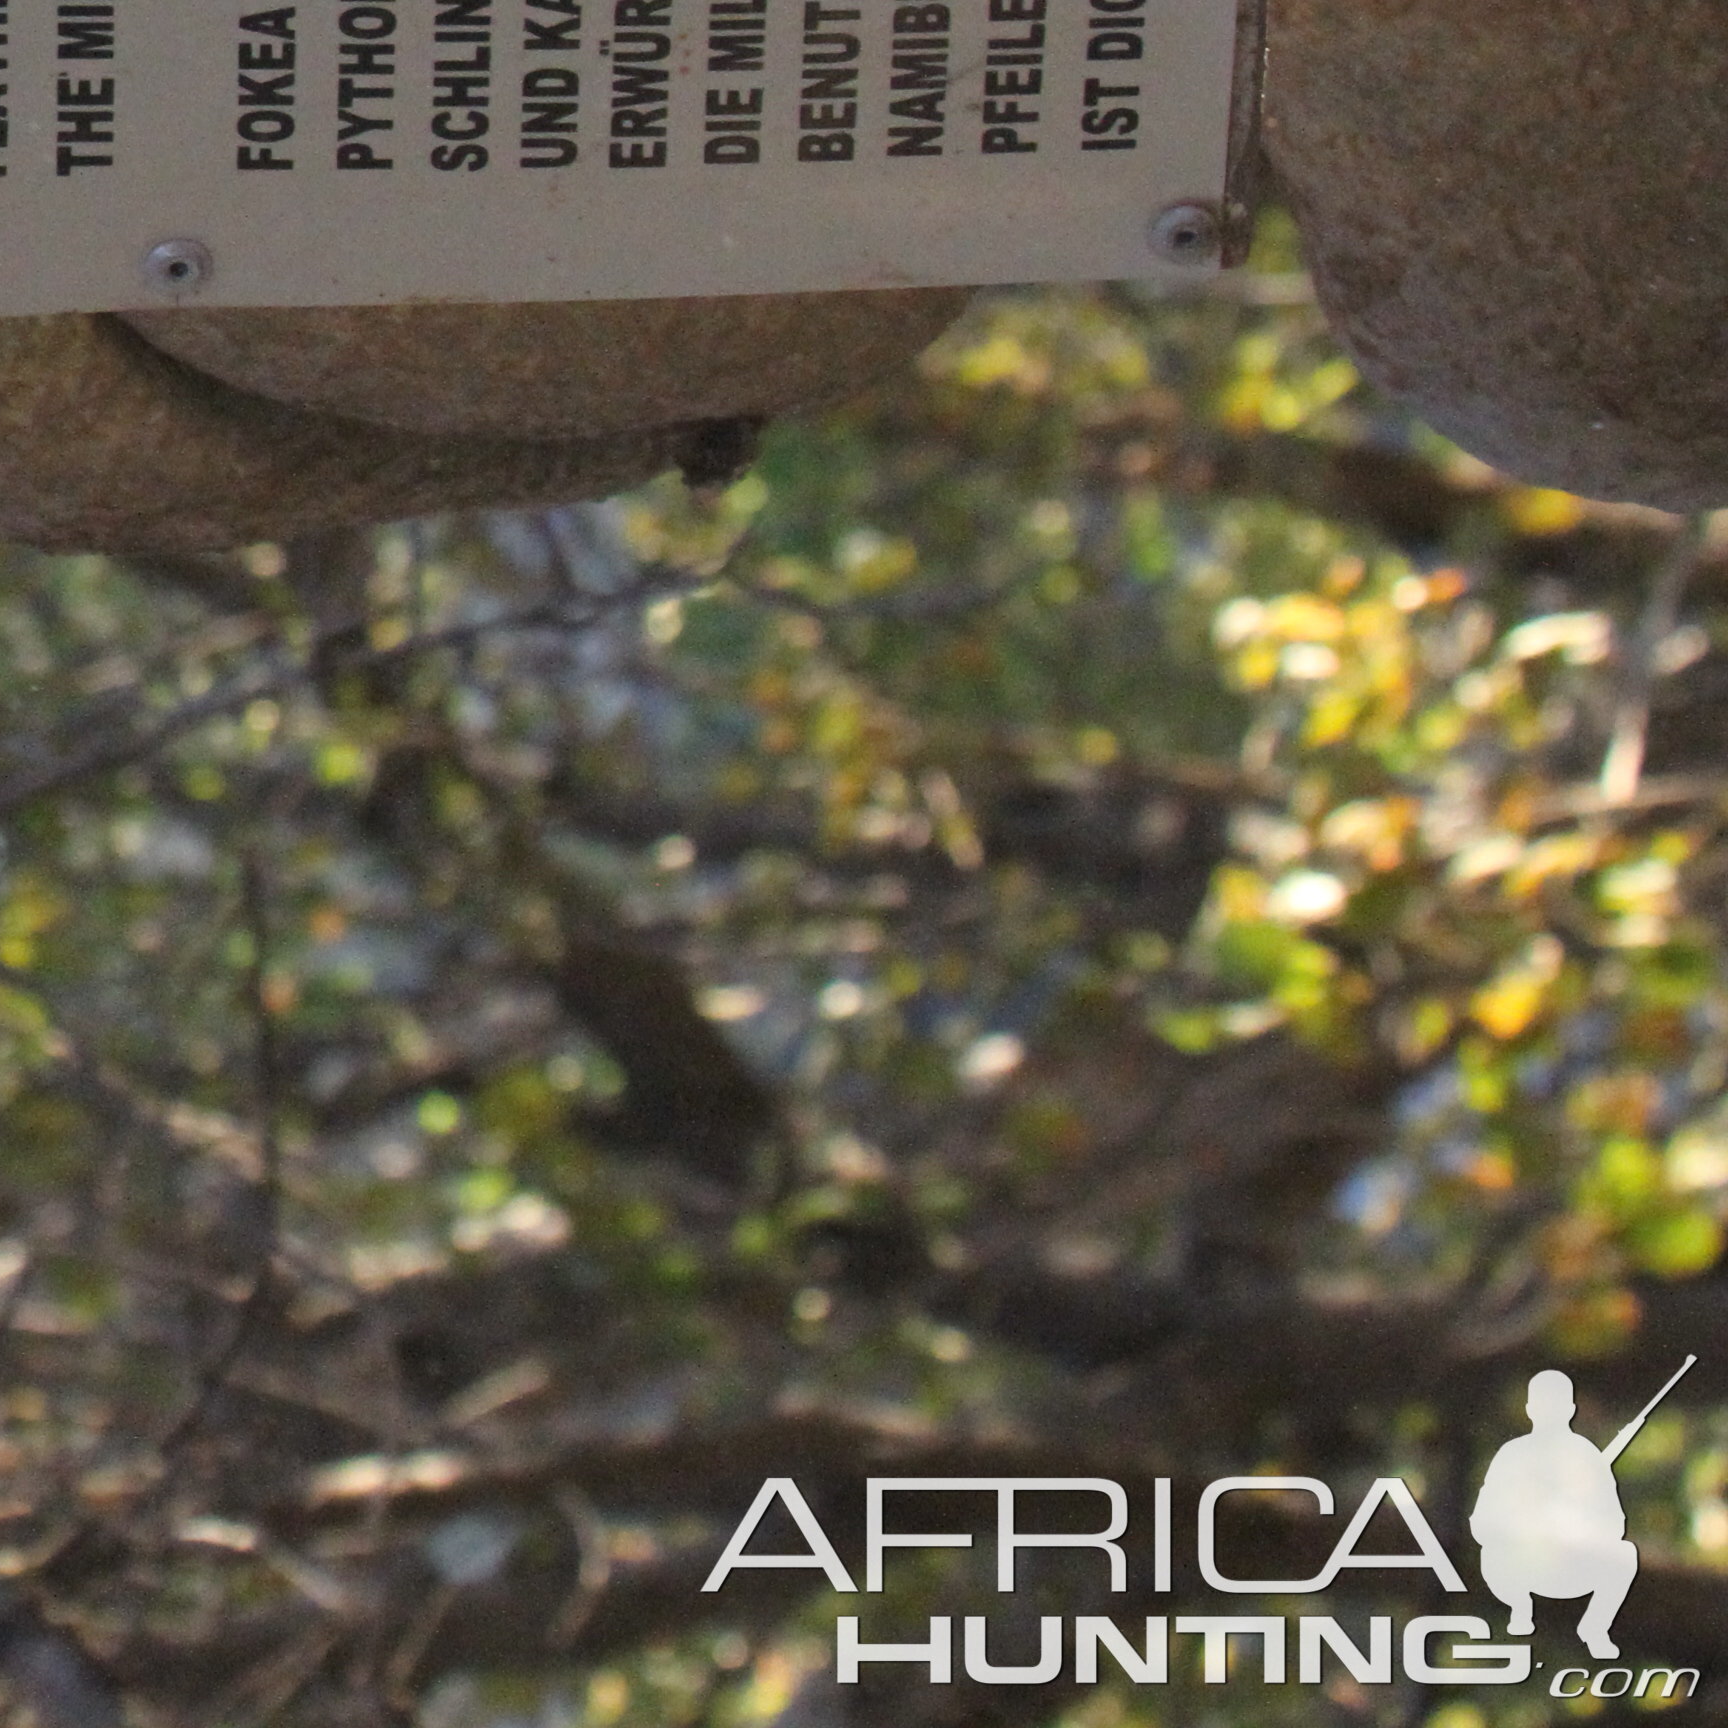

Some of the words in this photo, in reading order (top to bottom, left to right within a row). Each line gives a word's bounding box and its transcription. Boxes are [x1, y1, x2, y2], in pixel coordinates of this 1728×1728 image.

[56, 78, 115, 177] THE
[236, 6, 296, 171] FOKEA
[520, 68, 579, 168] UND
[704, 88, 763, 164] DIE
[1081, 78, 1140, 151] IST
